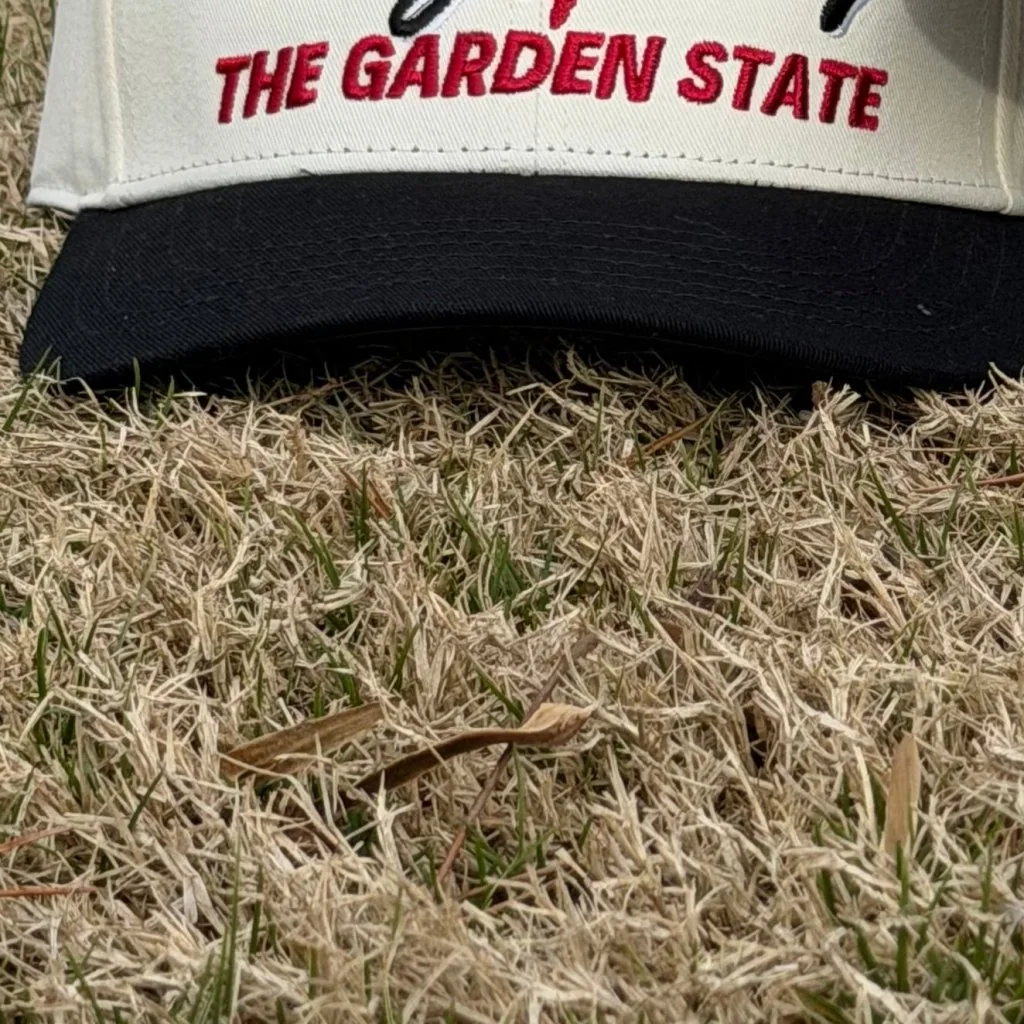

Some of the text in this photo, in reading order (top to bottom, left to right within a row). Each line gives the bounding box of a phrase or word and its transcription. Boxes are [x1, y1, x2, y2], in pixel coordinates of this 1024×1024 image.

[215, 31, 889, 131] THE GARDEN STATE
